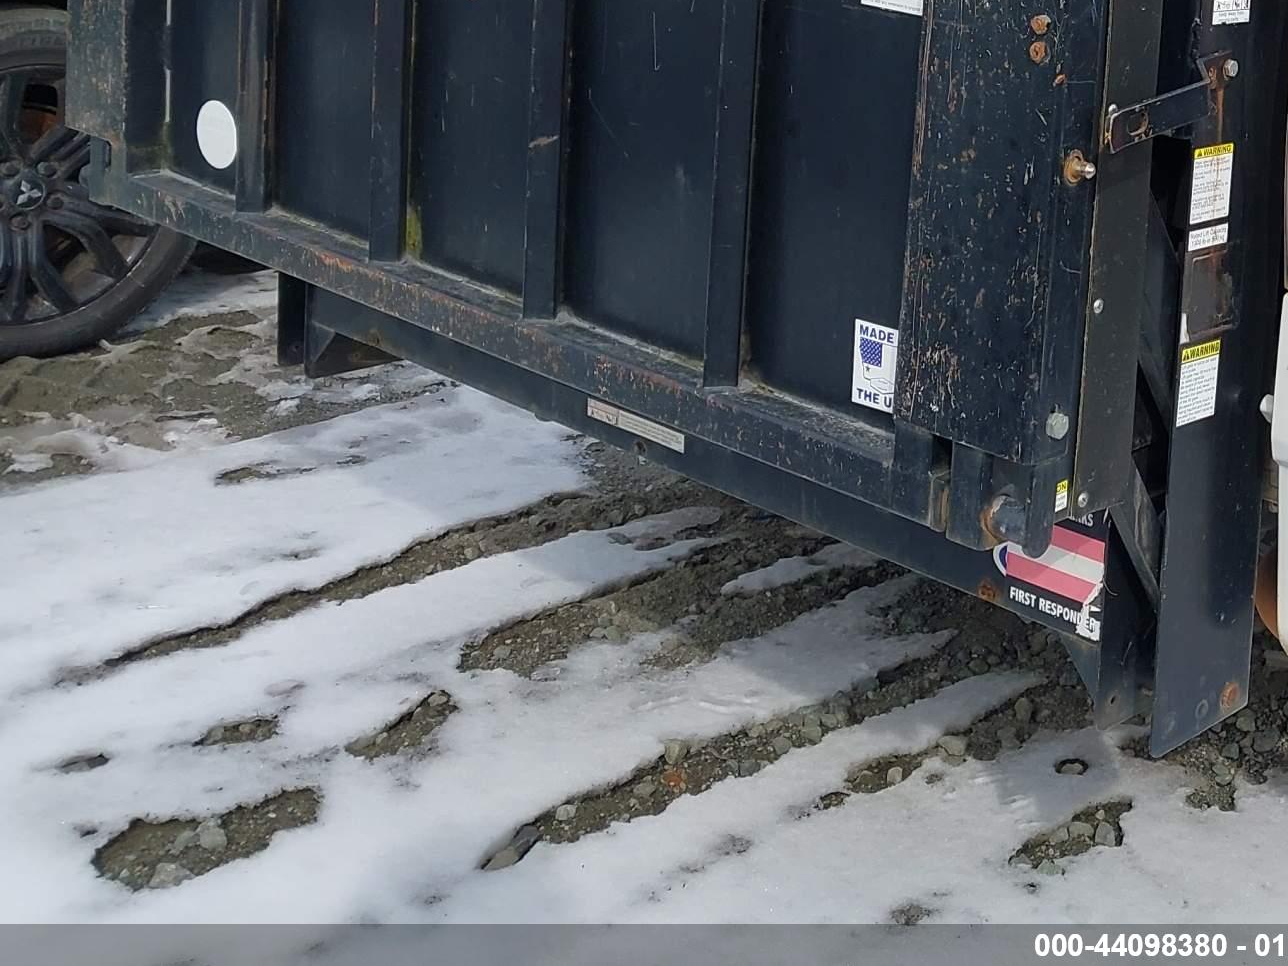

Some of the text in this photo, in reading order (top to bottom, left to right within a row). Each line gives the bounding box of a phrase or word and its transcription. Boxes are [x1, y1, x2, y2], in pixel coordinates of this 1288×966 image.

[1203, 144, 1232, 156] WARNING
[860, 324, 895, 343] MADE
[1190, 342, 1219, 359] WARNING
[856, 387, 880, 405] THE
[1009, 586, 1096, 632] FIRST RESPONDER
